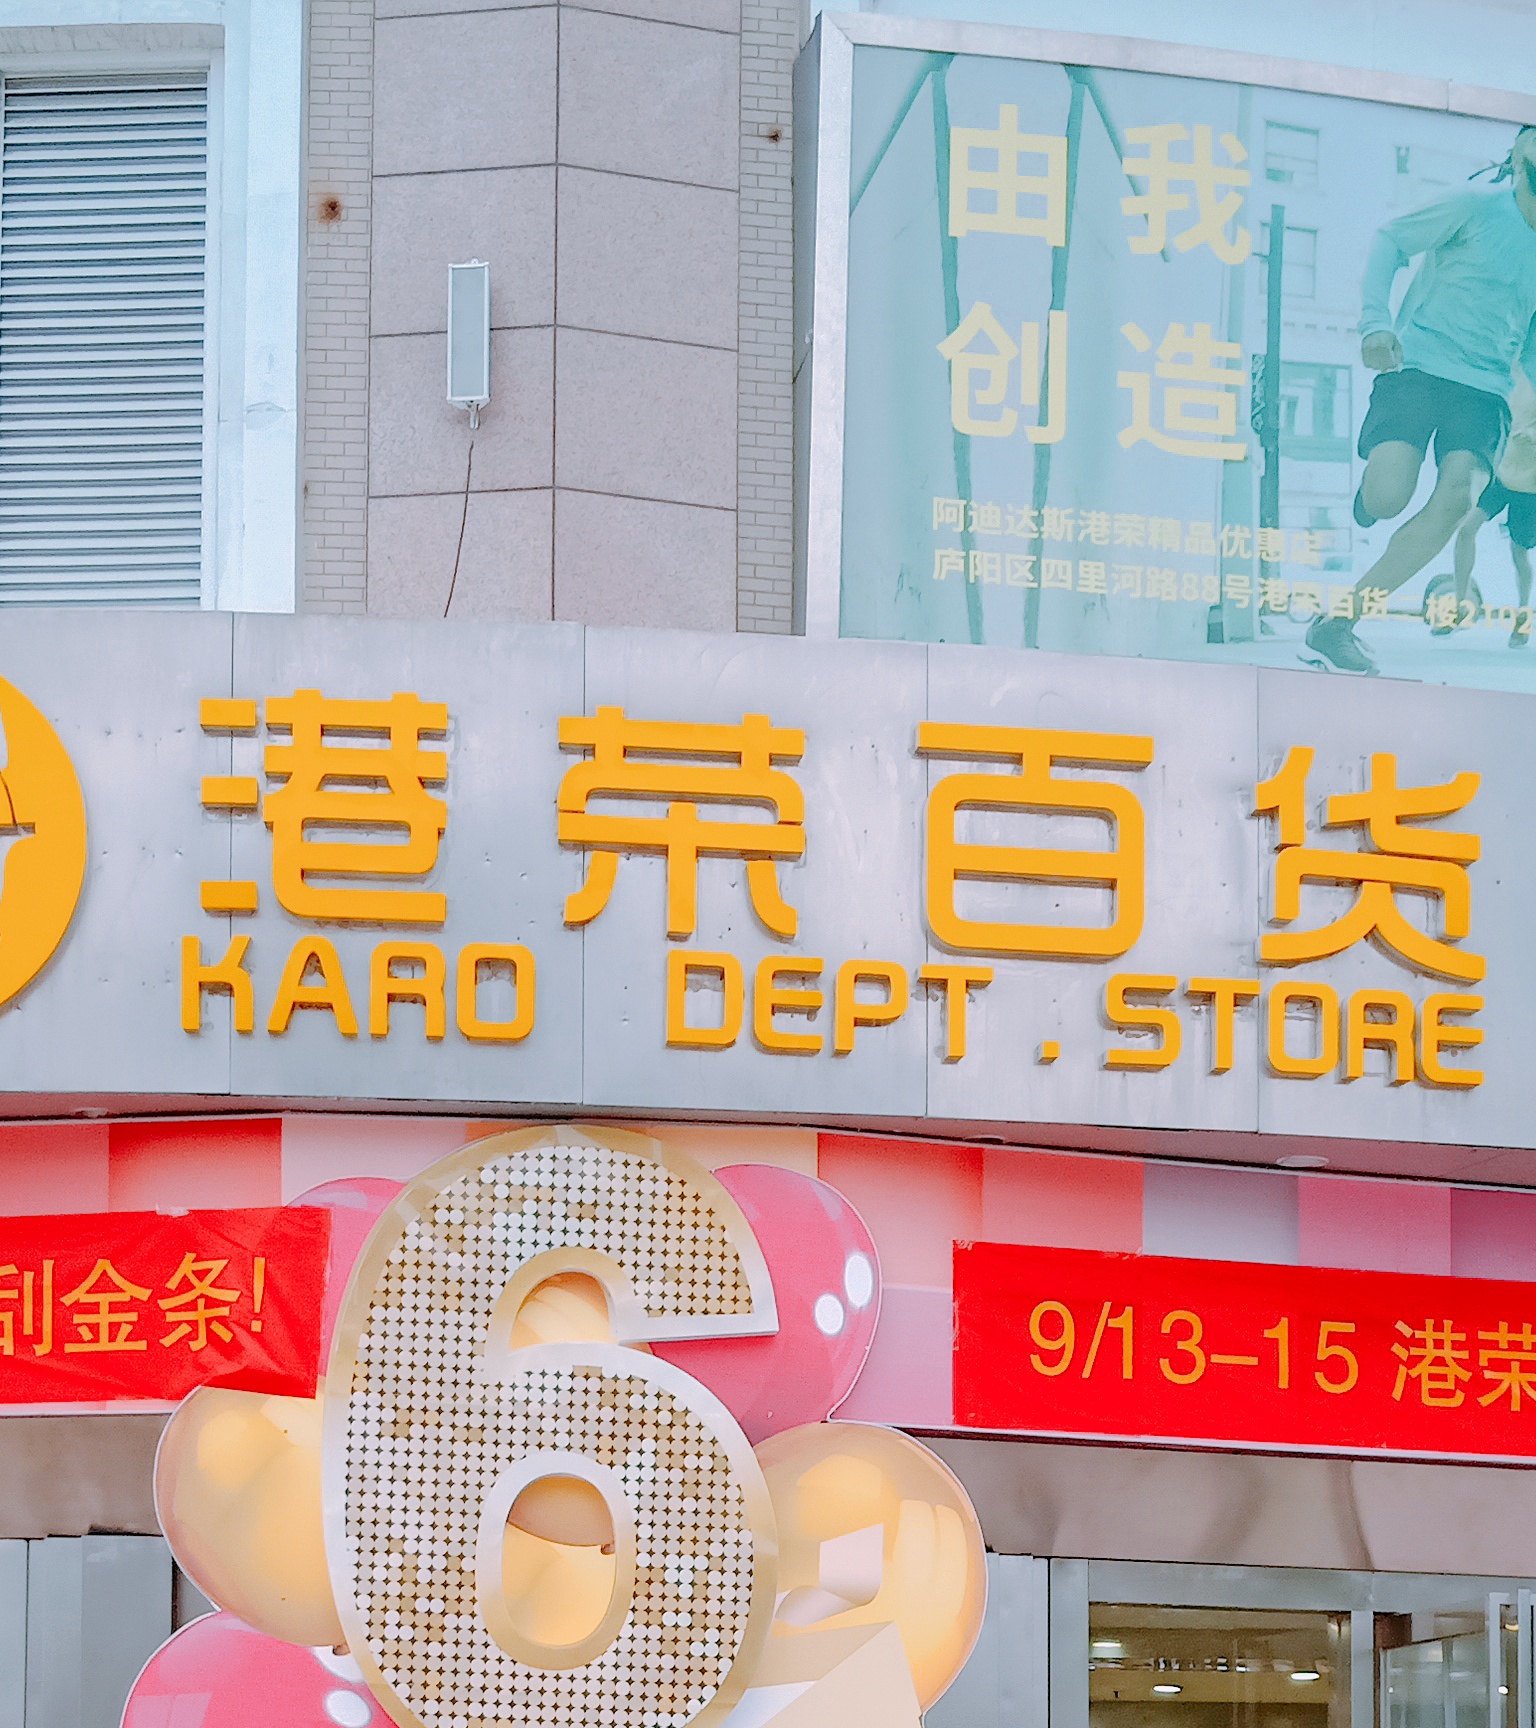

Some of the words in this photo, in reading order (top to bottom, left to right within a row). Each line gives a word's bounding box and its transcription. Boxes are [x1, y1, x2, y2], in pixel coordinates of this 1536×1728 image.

[199, 688, 1487, 983] 港荣百货
[180, 934, 537, 1044] KARO
